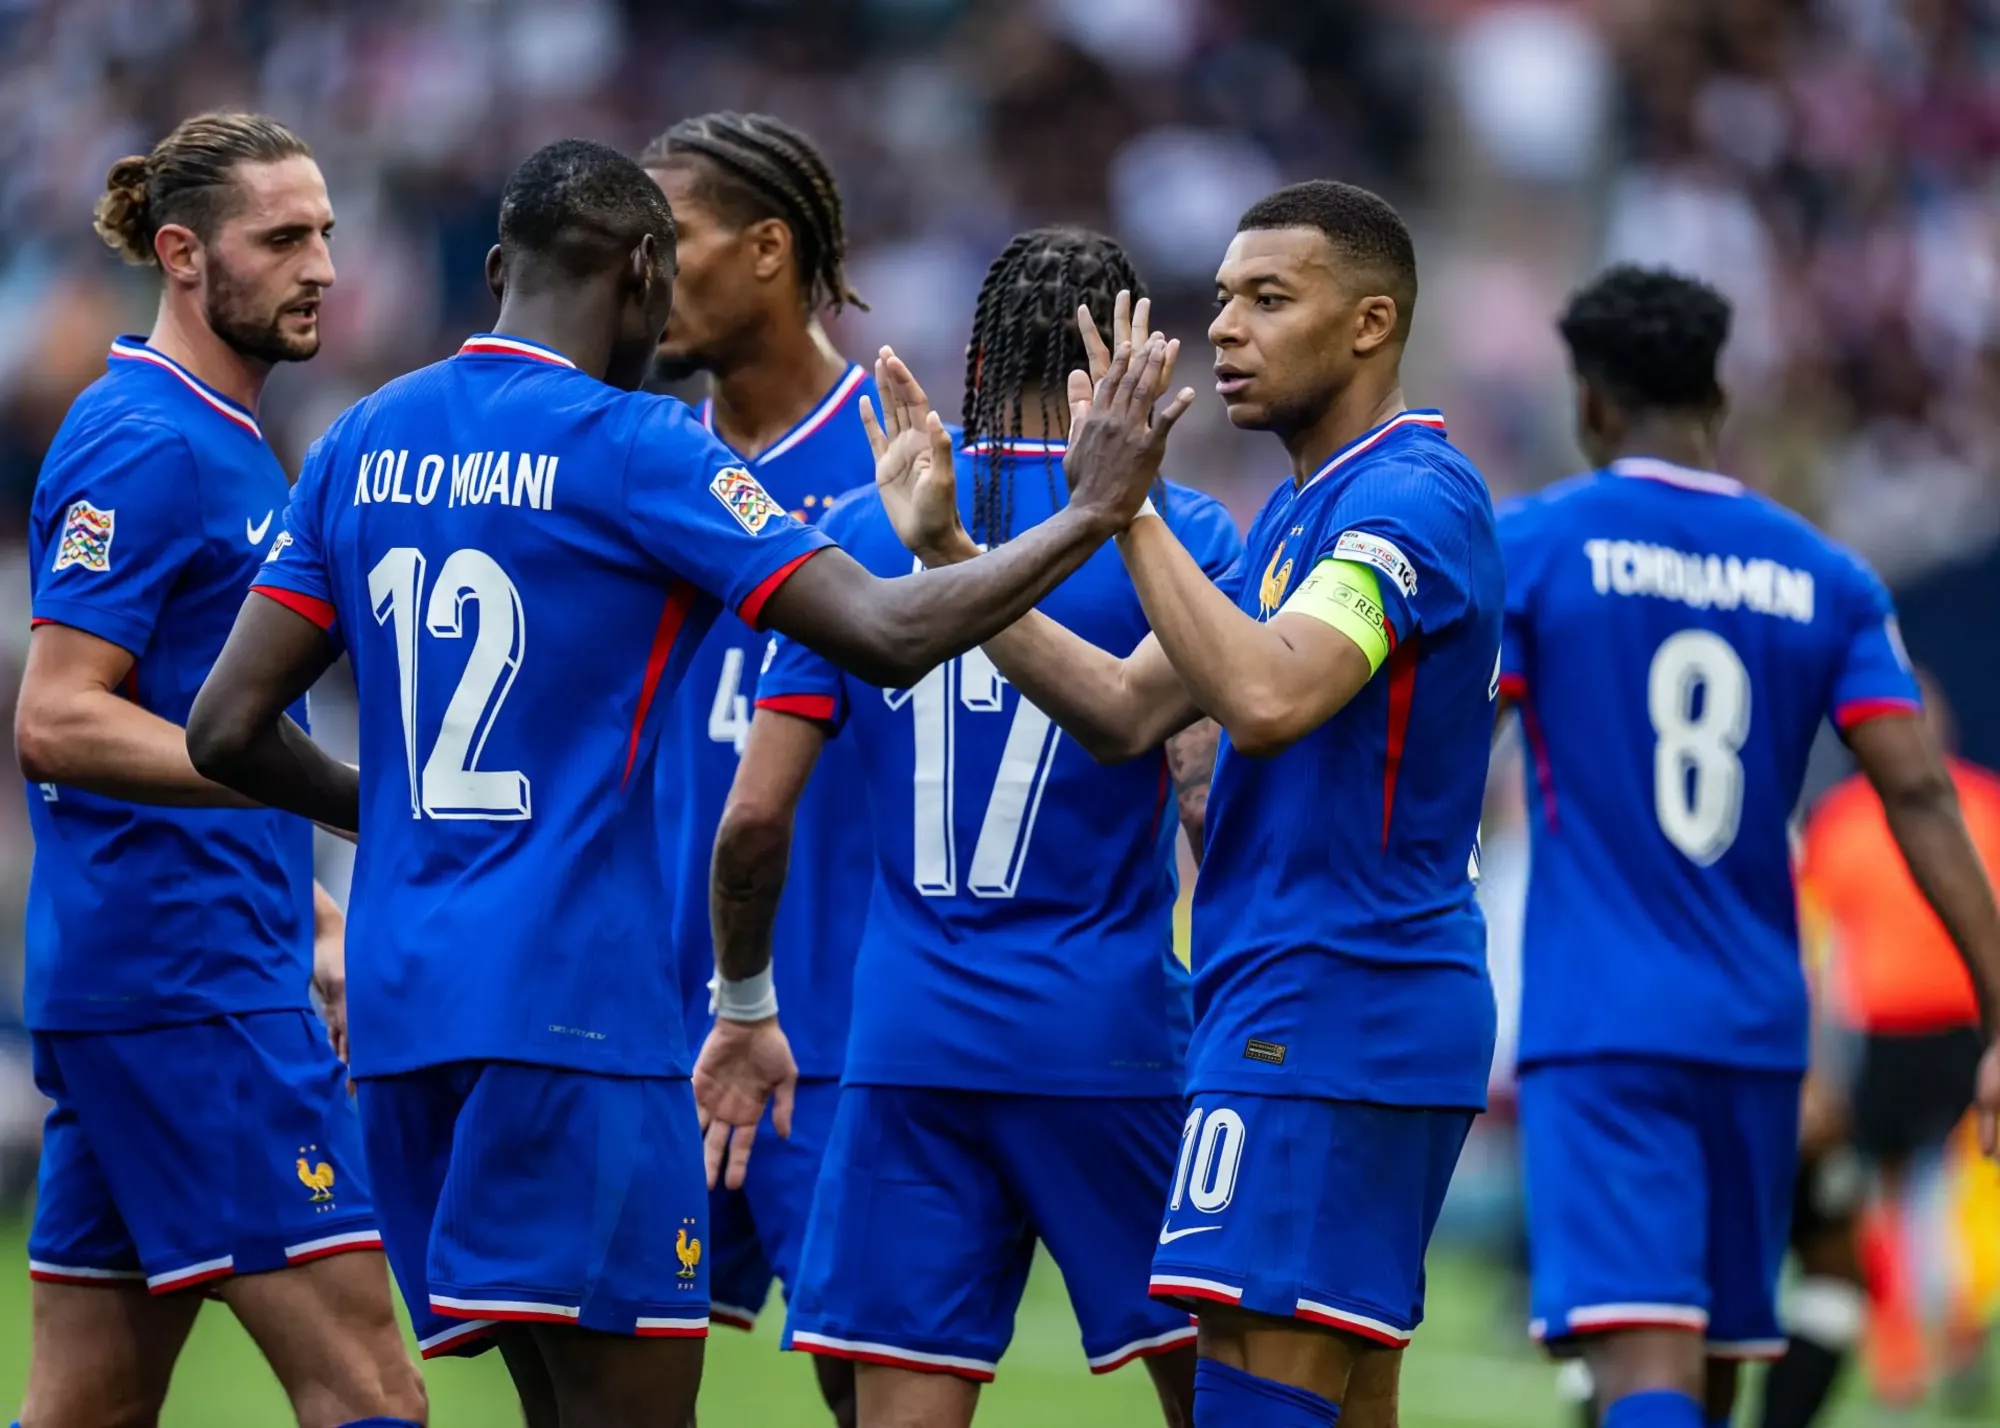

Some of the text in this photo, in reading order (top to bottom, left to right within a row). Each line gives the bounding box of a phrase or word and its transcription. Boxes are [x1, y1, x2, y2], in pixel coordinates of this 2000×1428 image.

[354, 449, 559, 510] KOLO MUANI
[367, 547, 532, 820] 12
[708, 648, 752, 755] 4
[883, 547, 1062, 899] 17
[1648, 629, 1751, 868] 8
[1170, 1107, 1246, 1214] 10
